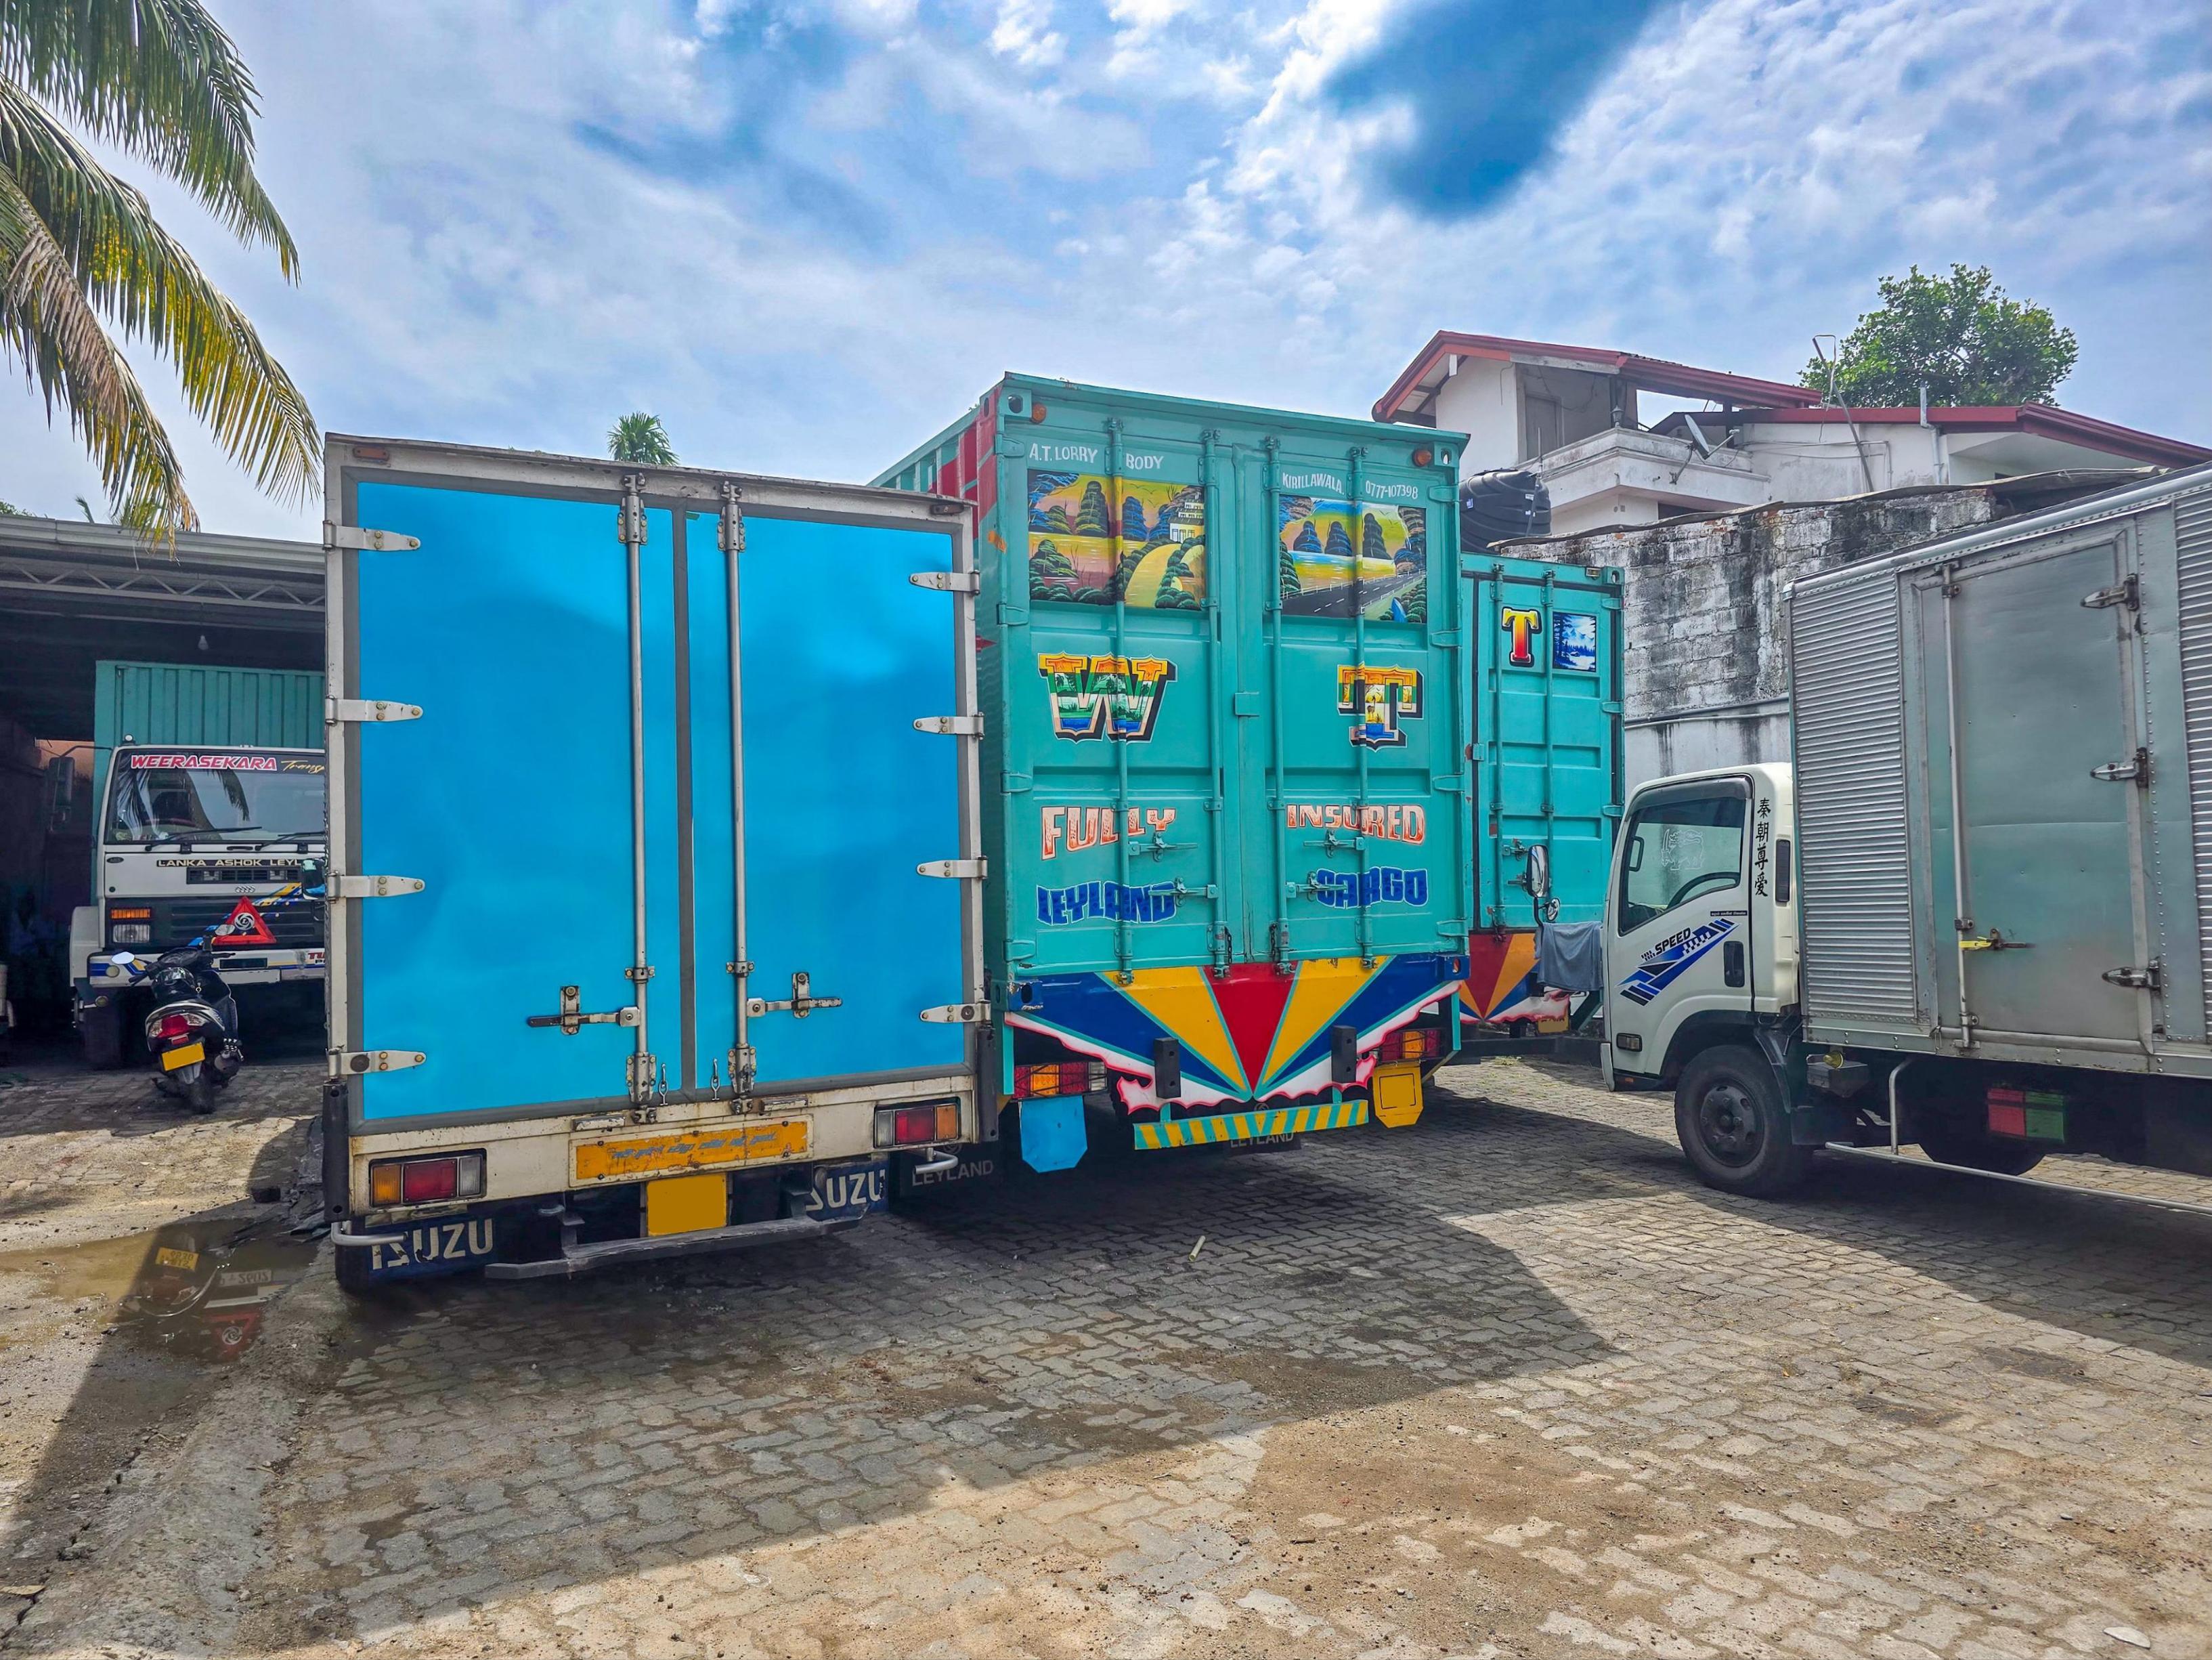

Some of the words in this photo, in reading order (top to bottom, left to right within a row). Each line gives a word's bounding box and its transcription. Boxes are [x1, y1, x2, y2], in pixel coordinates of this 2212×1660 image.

[1029, 443, 1052, 461] A.T.
[1055, 446, 1098, 463] LORRY
[1126, 453, 1164, 470] BODY
[1365, 480, 1418, 499] 0777-107398
[1501, 606, 1542, 666] T
[1037, 651, 1178, 744] W
[1337, 661, 1424, 752] T
[131, 755, 277, 771] WEERASEKARA
[1041, 806, 1176, 861] FULLY
[1286, 804, 1425, 845] INSURED
[158, 859, 207, 867] LANKA
[270, 858, 301, 866] LEYL
[1037, 880, 1177, 926] LEYLAND
[1316, 866, 1428, 909] CARGO
[1655, 927, 1691, 956] SPEED
[806, 1169, 886, 1211] SUZU
[912, 1160, 993, 1187] LEYLAND
[372, 1218, 494, 1270] ISUZU
